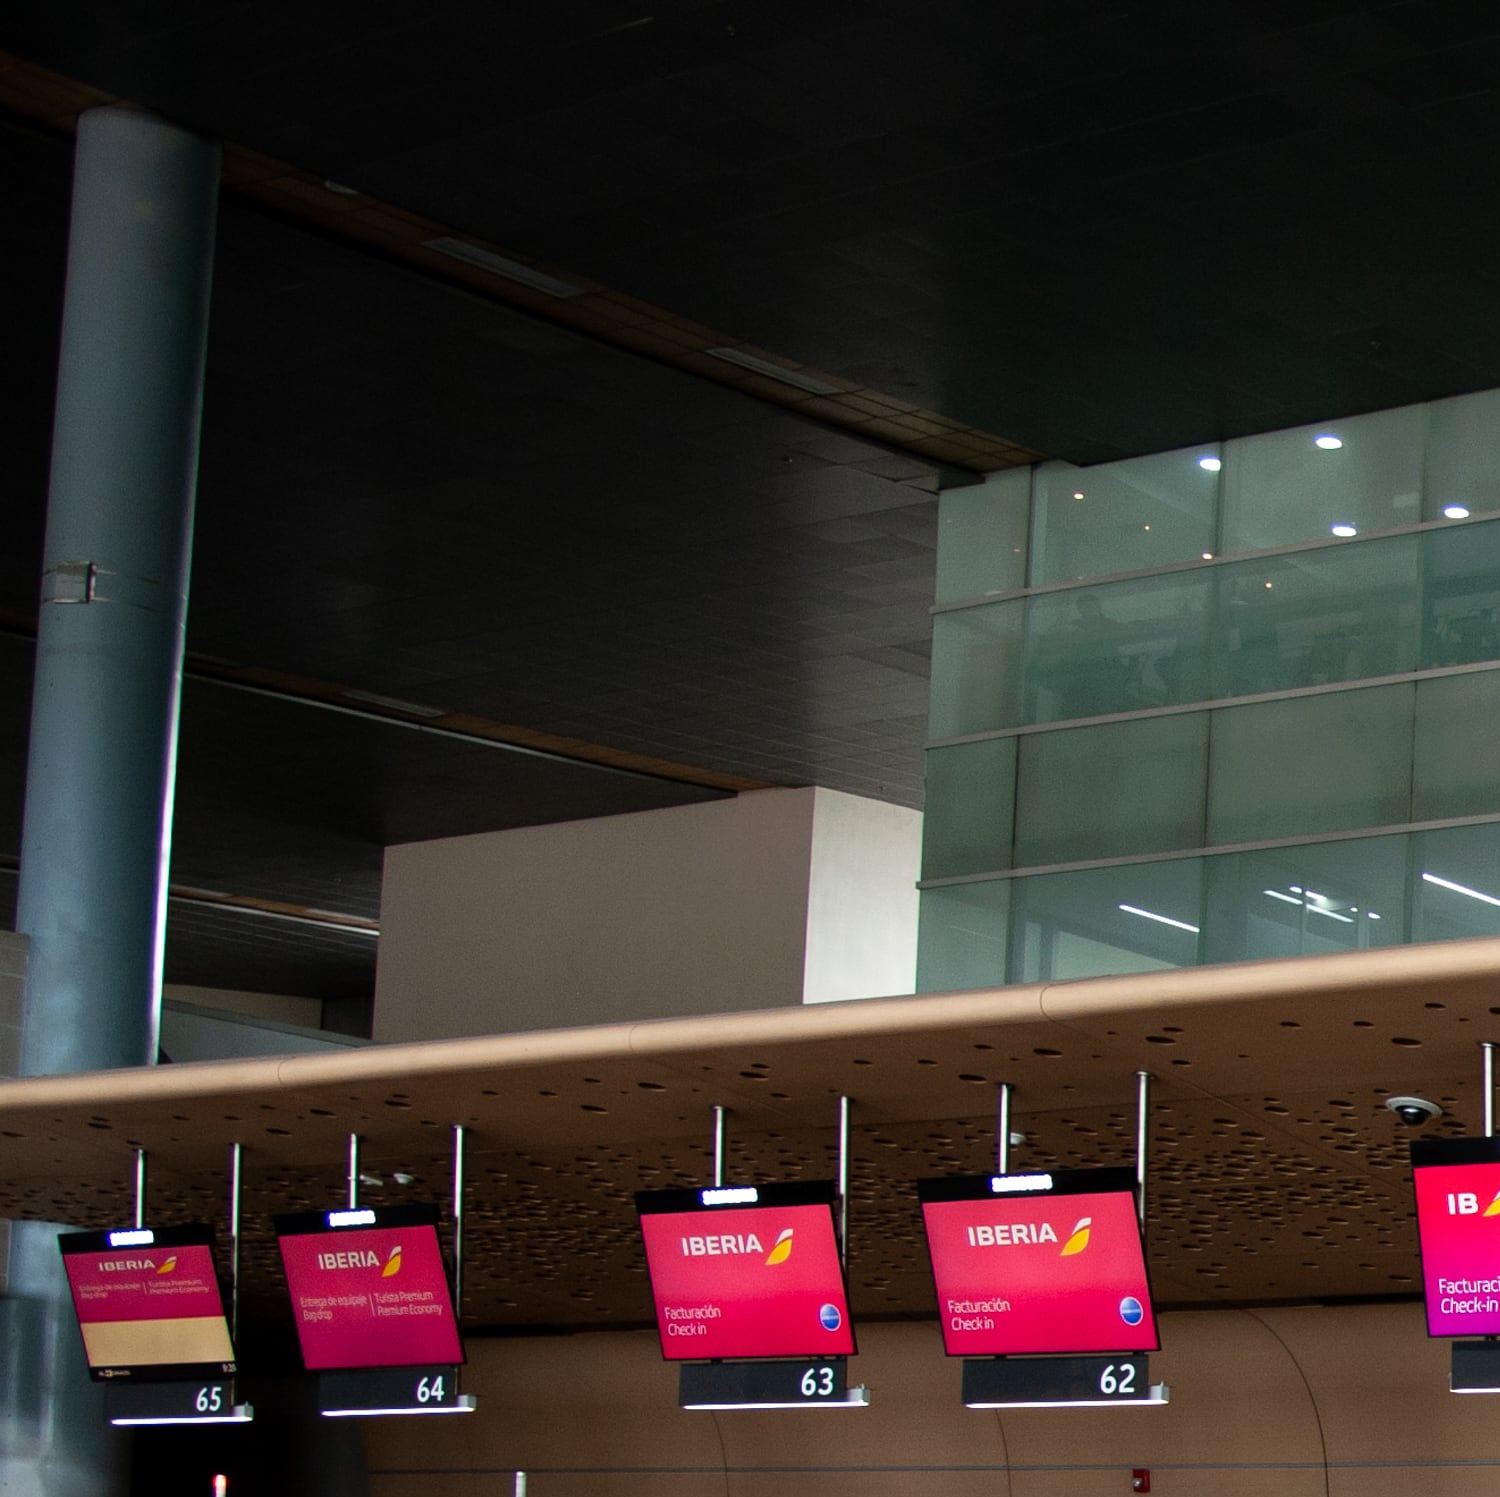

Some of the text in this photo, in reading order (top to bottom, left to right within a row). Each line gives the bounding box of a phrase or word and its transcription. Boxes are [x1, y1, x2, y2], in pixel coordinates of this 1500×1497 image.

[1448, 1193, 1478, 1215] IB
[681, 1234, 763, 1256] IBERIA
[968, 1223, 1058, 1246] IBERIA
[99, 1260, 155, 1271] IBERIA
[318, 1251, 380, 1270] IBERIA
[664, 1305, 721, 1319] Facturación
[948, 1298, 1010, 1313] Facturación
[1441, 1296, 1499, 1313] Check-in
[417, 1376, 444, 1402] 64
[801, 1368, 834, 1396] 63
[1100, 1364, 1135, 1394] 62
[196, 1387, 222, 1411] 65
